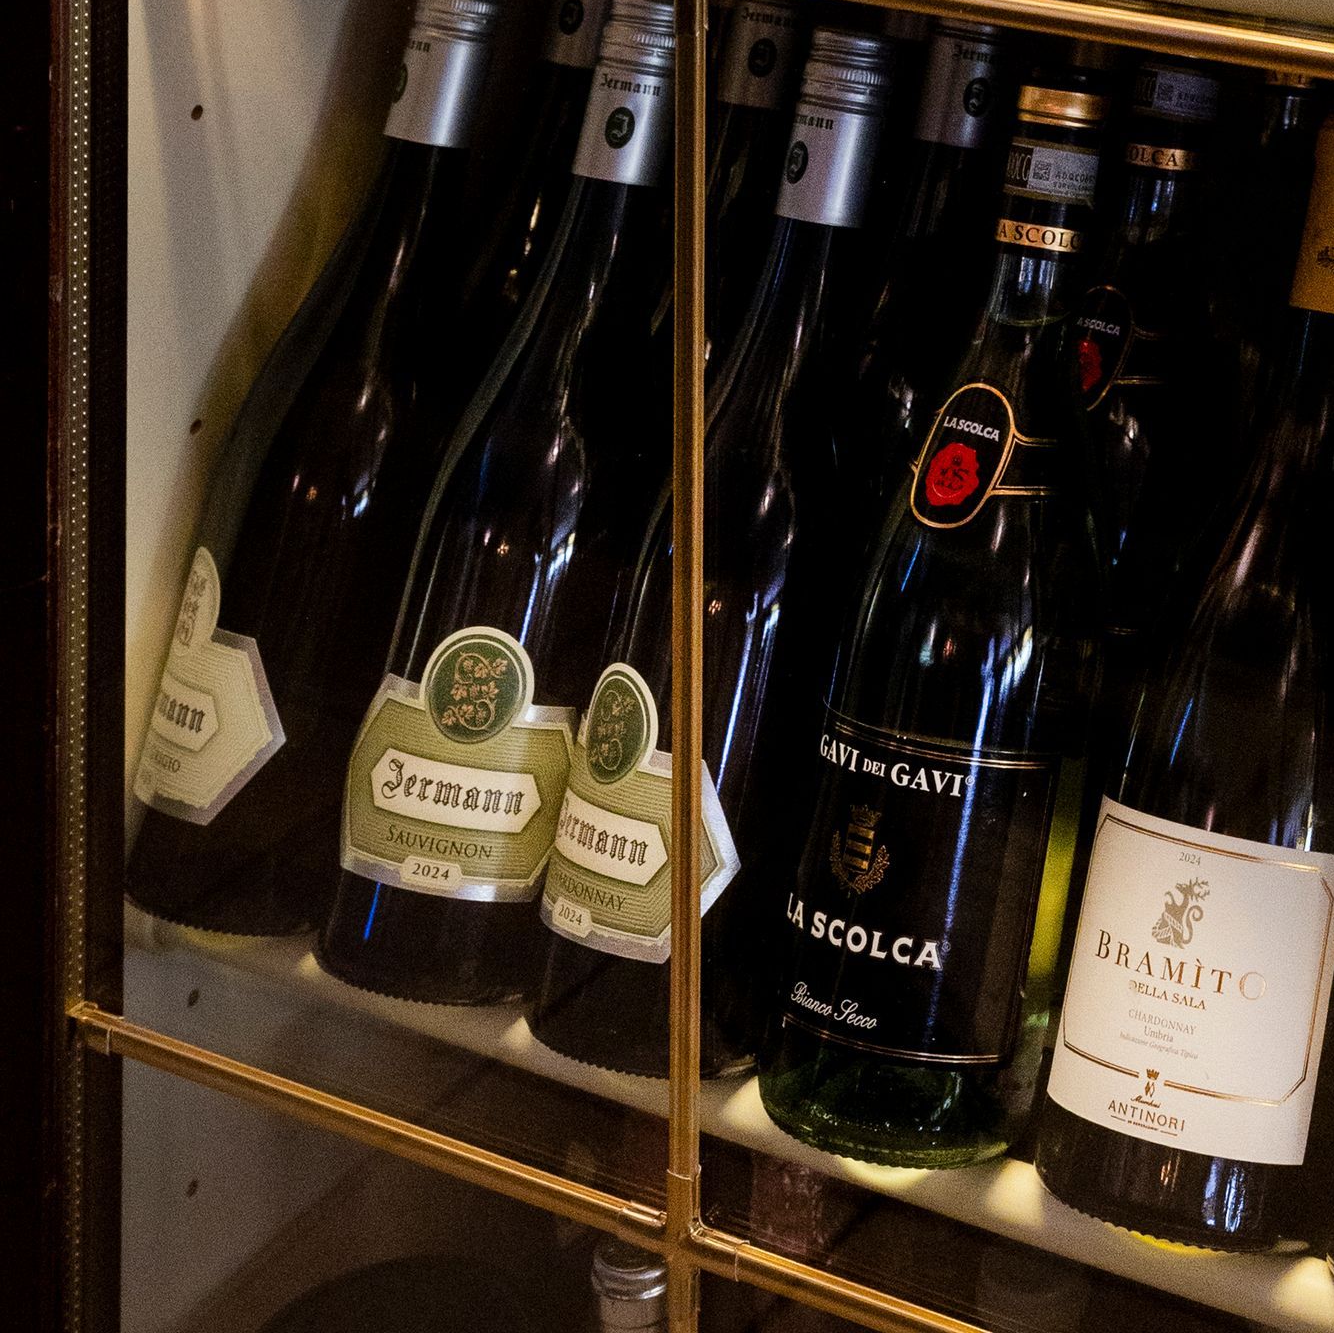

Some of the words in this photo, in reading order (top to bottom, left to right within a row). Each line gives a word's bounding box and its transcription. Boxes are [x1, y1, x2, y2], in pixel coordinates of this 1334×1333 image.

[943, 415, 959, 429] LA
[957, 418, 1001, 443] SCOLCA
[820, 733, 860, 773] GAVI
[862, 756, 887, 779] DEI
[890, 761, 964, 798] GAVI
[380, 756, 528, 817] Jermann
[386, 823, 494, 860] SAUVIGNON
[411, 861, 451, 882] 2024
[1178, 851, 1202, 867] 2024
[557, 902, 584, 927] 2024
[786, 891, 804, 931] LA
[810, 911, 944, 972] SCOLCA
[1095, 928, 1268, 1001] BRAMÌTO
[790, 980, 833, 1018] Bianco
[833, 997, 878, 1031] Secco
[1129, 979, 1169, 1002] DELLA
[1171, 990, 1208, 1012] SALA
[1128, 1009, 1198, 1035] CHARDONNAY
[1144, 1025, 1175, 1044] Umbria
[1107, 1098, 1186, 1132] ANTINORI
